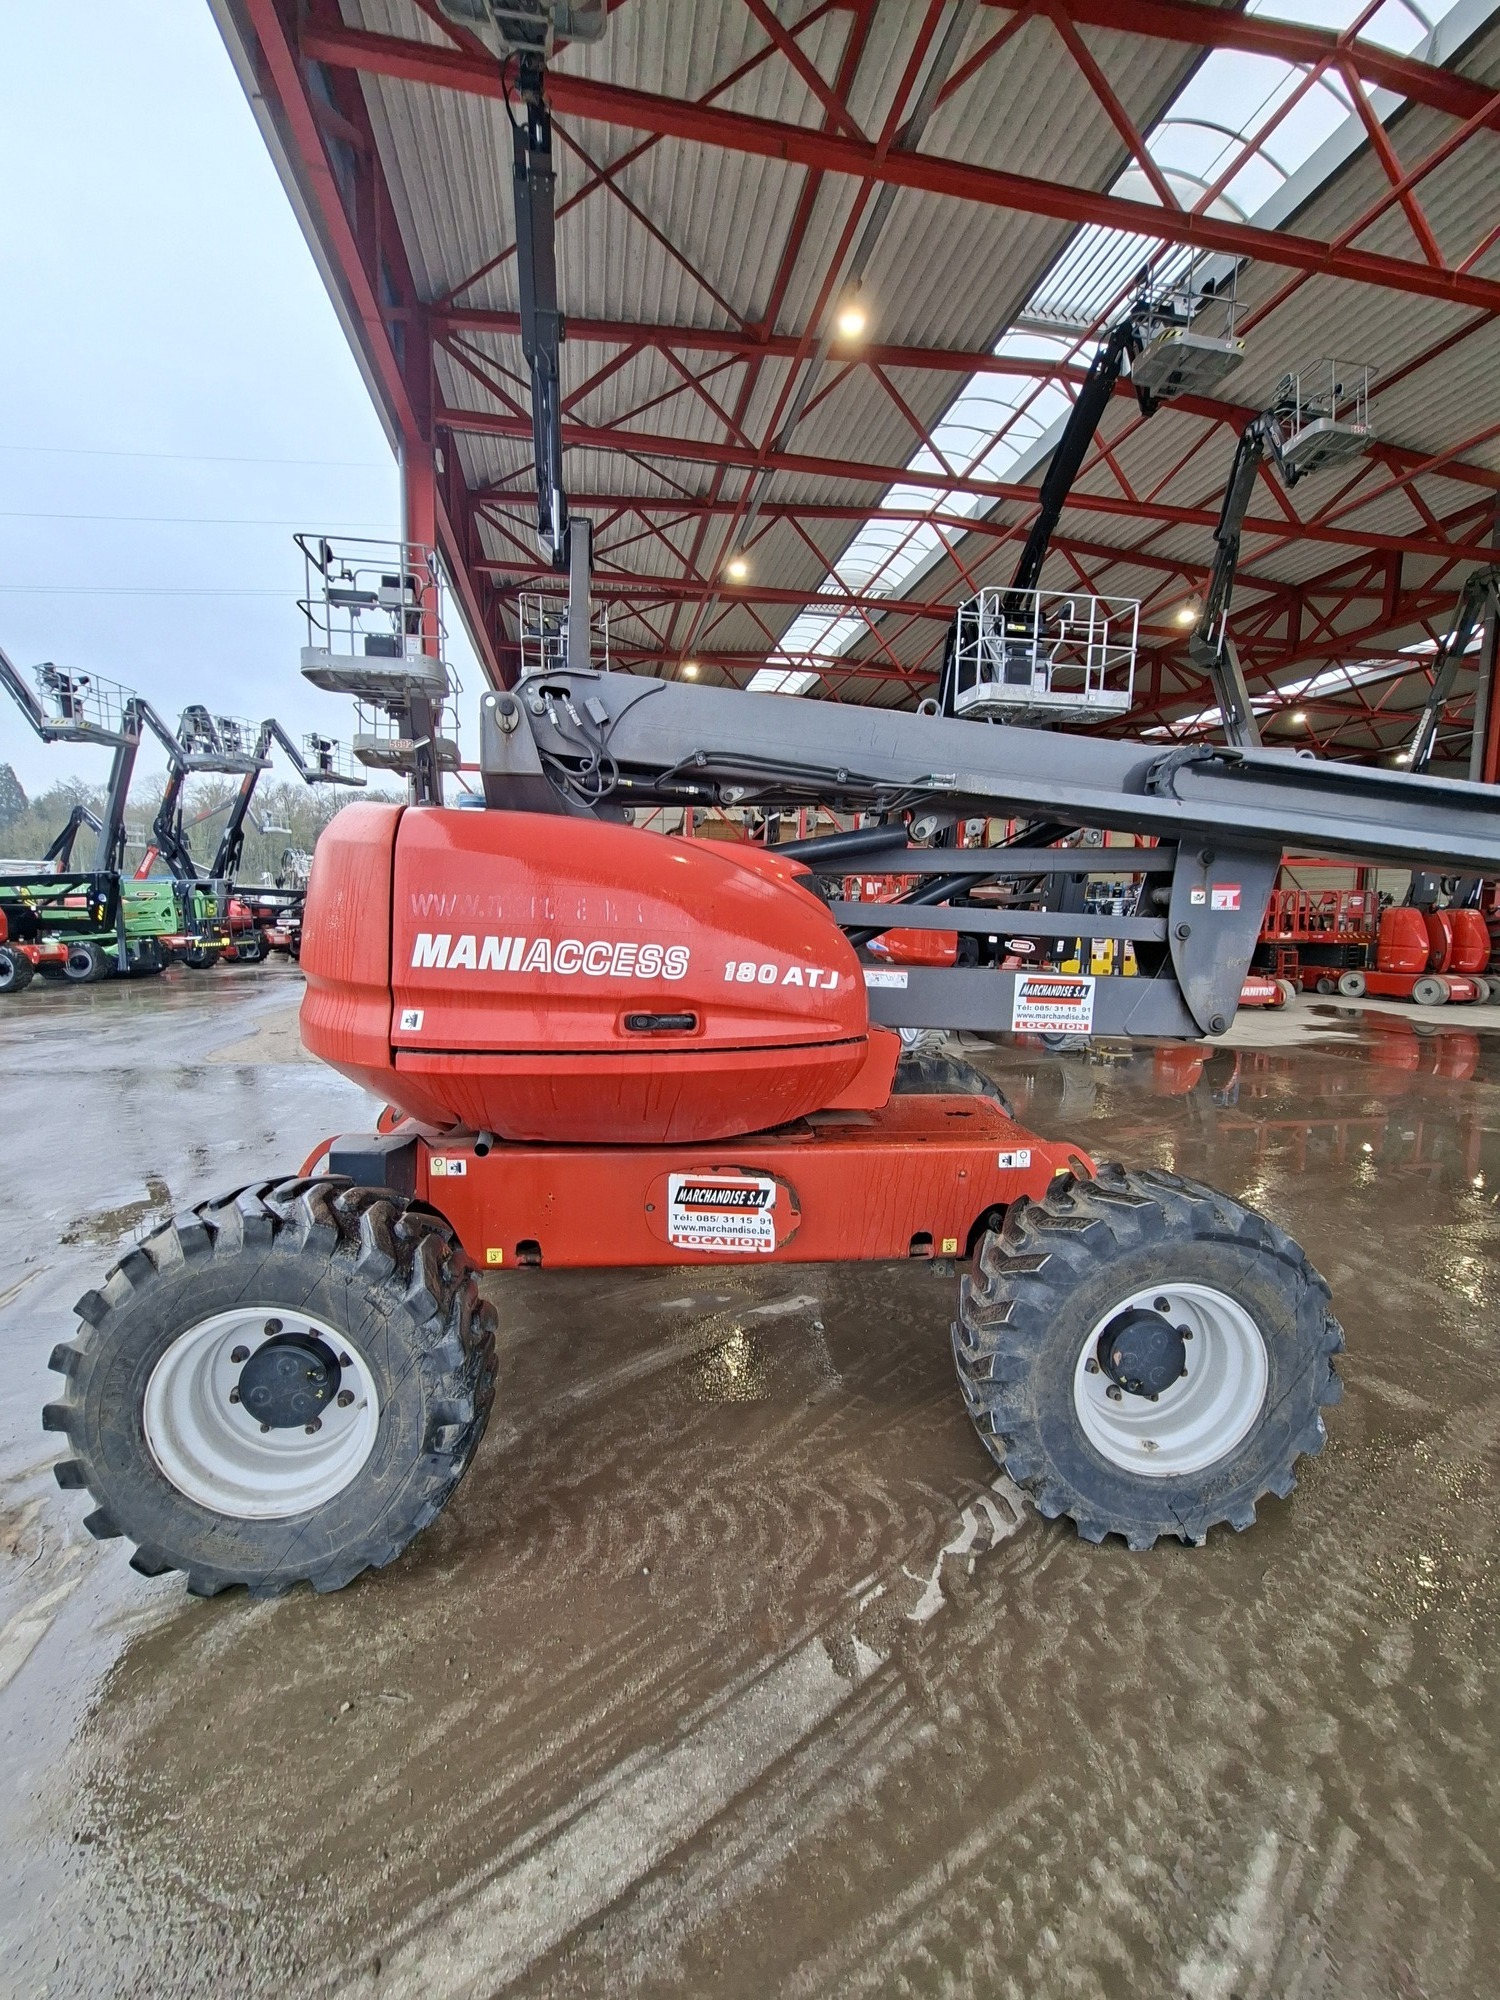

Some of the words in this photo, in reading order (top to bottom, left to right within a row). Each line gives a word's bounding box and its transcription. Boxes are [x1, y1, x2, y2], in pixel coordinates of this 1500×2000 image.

[390, 739, 413, 749] 5692
[411, 933, 690, 980] MANIACCESS
[724, 960, 778, 985] 180
[781, 965, 839, 990] ATJ
[1021, 985, 1074, 997] MARCHANDISE
[1074, 986, 1087, 997] S.A.
[1017, 1013, 1090, 1021] www.marchandise.be
[1019, 1022, 1085, 1030] LOCATION
[677, 1188, 748, 1205] MARCHANDISE
[747, 1193, 766, 1206] S.A.
[673, 1213, 693, 1222] Tél:
[696, 1214, 720, 1223] 085/
[723, 1215, 735, 1224] 31
[740, 1216, 753, 1225] 15
[760, 1218, 772, 1226] 91
[673, 1224, 771, 1235] www.marchandise.be
[678, 1235, 766, 1247] LOCATION
